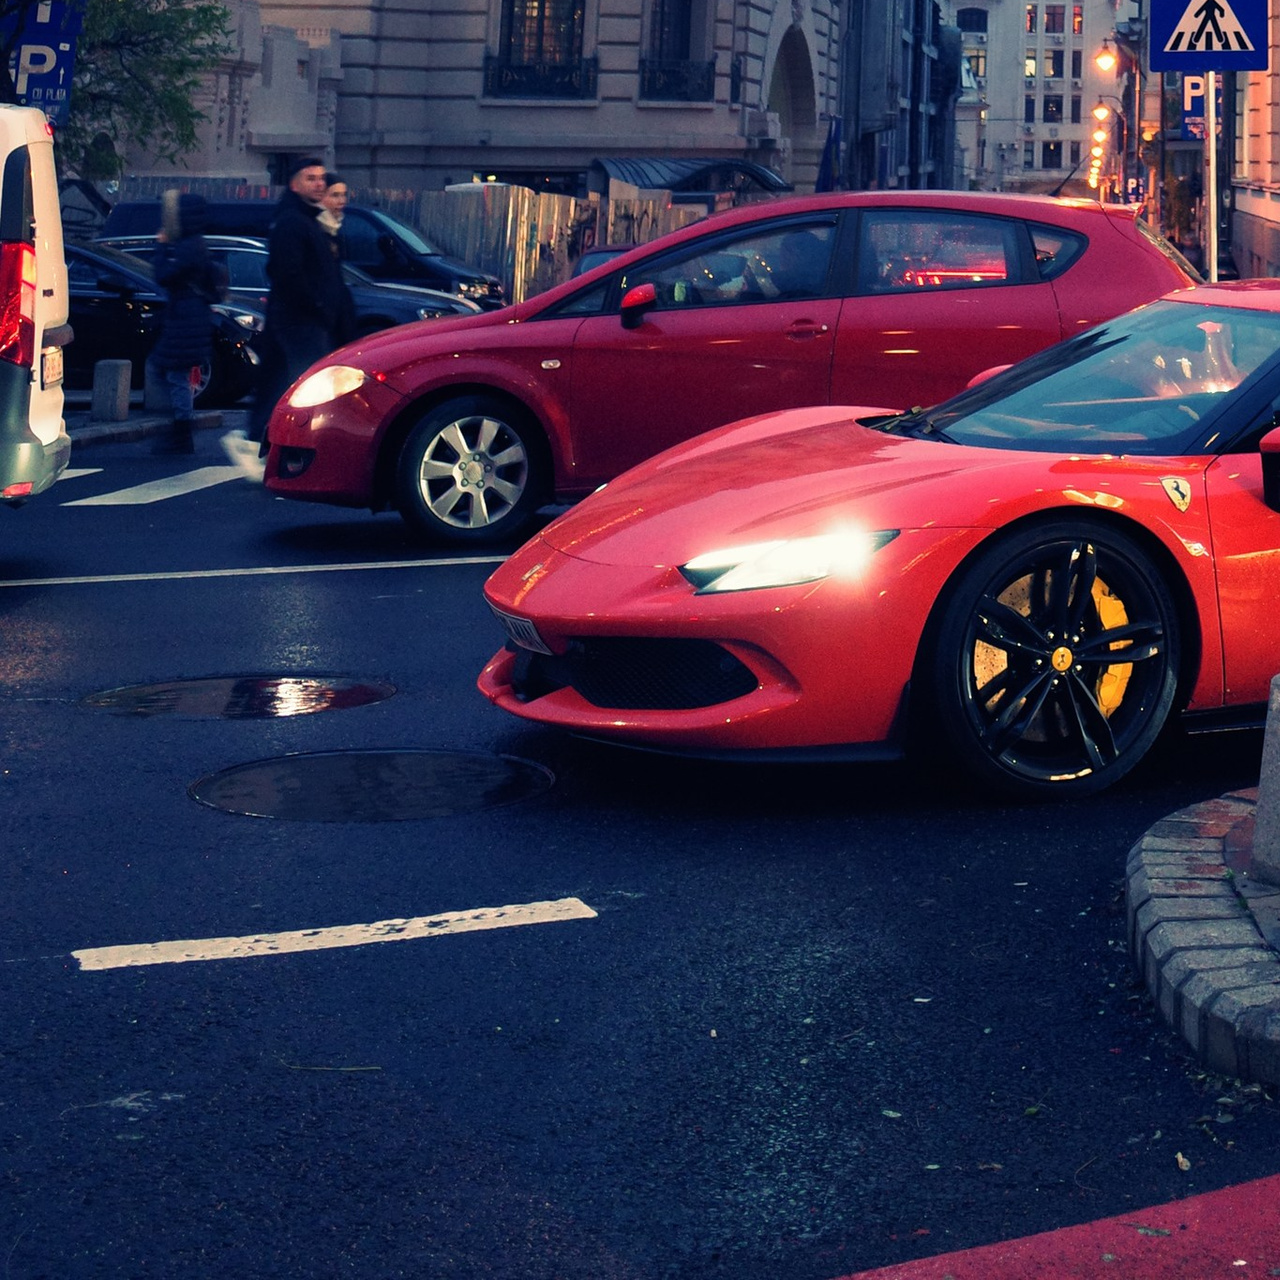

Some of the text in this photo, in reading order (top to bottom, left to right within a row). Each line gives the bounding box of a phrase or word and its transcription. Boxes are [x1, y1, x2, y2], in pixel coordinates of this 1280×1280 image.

[16, 44, 57, 95] P
[1184, 75, 1205, 111] P
[1127, 178, 1137, 194] P
